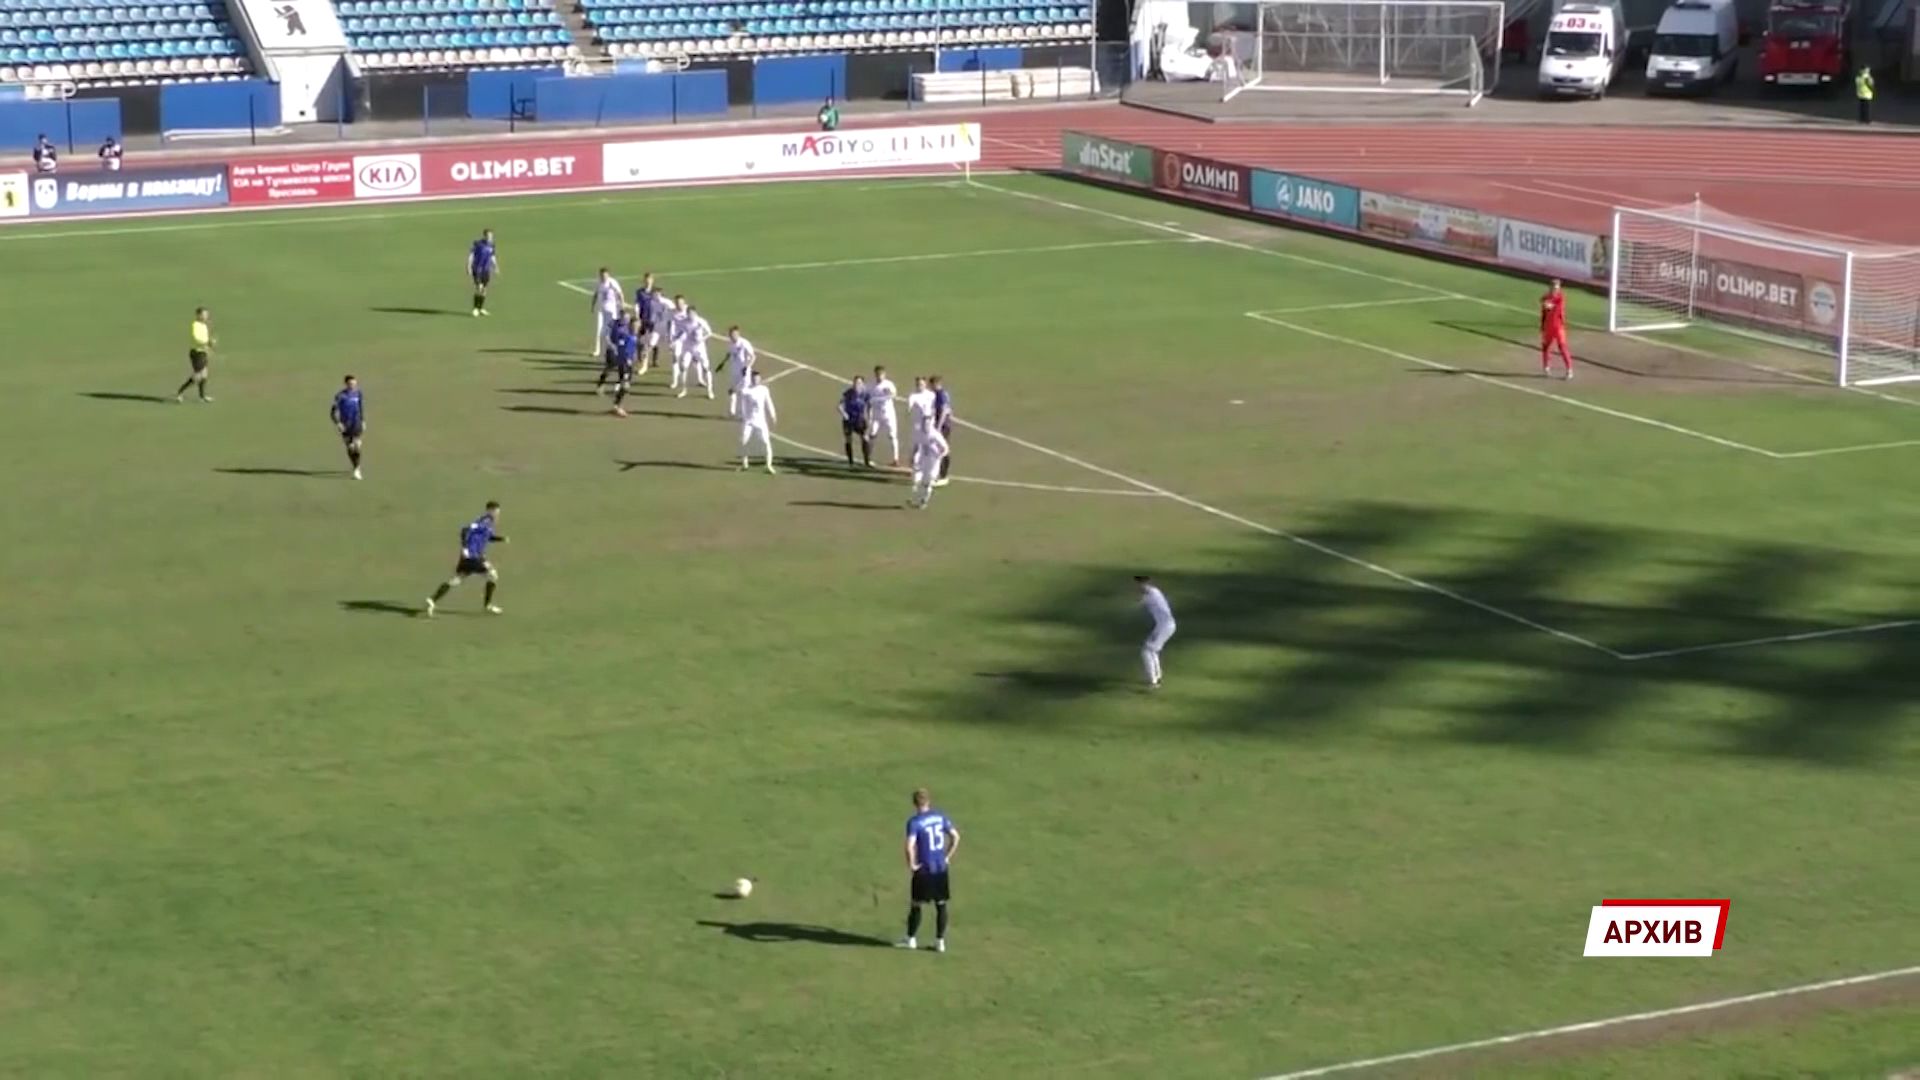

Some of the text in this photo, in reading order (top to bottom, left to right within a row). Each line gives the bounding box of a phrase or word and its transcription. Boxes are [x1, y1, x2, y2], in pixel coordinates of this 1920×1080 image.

[369, 167, 407, 184] KIA
[450, 156, 576, 181] OLIMP.BET
[1182, 162, 1239, 192] ОЛИМП
[1296, 185, 1335, 214] JAKO
[1716, 274, 1799, 306] OLIMP.BET
[925, 823, 944, 851] 15
